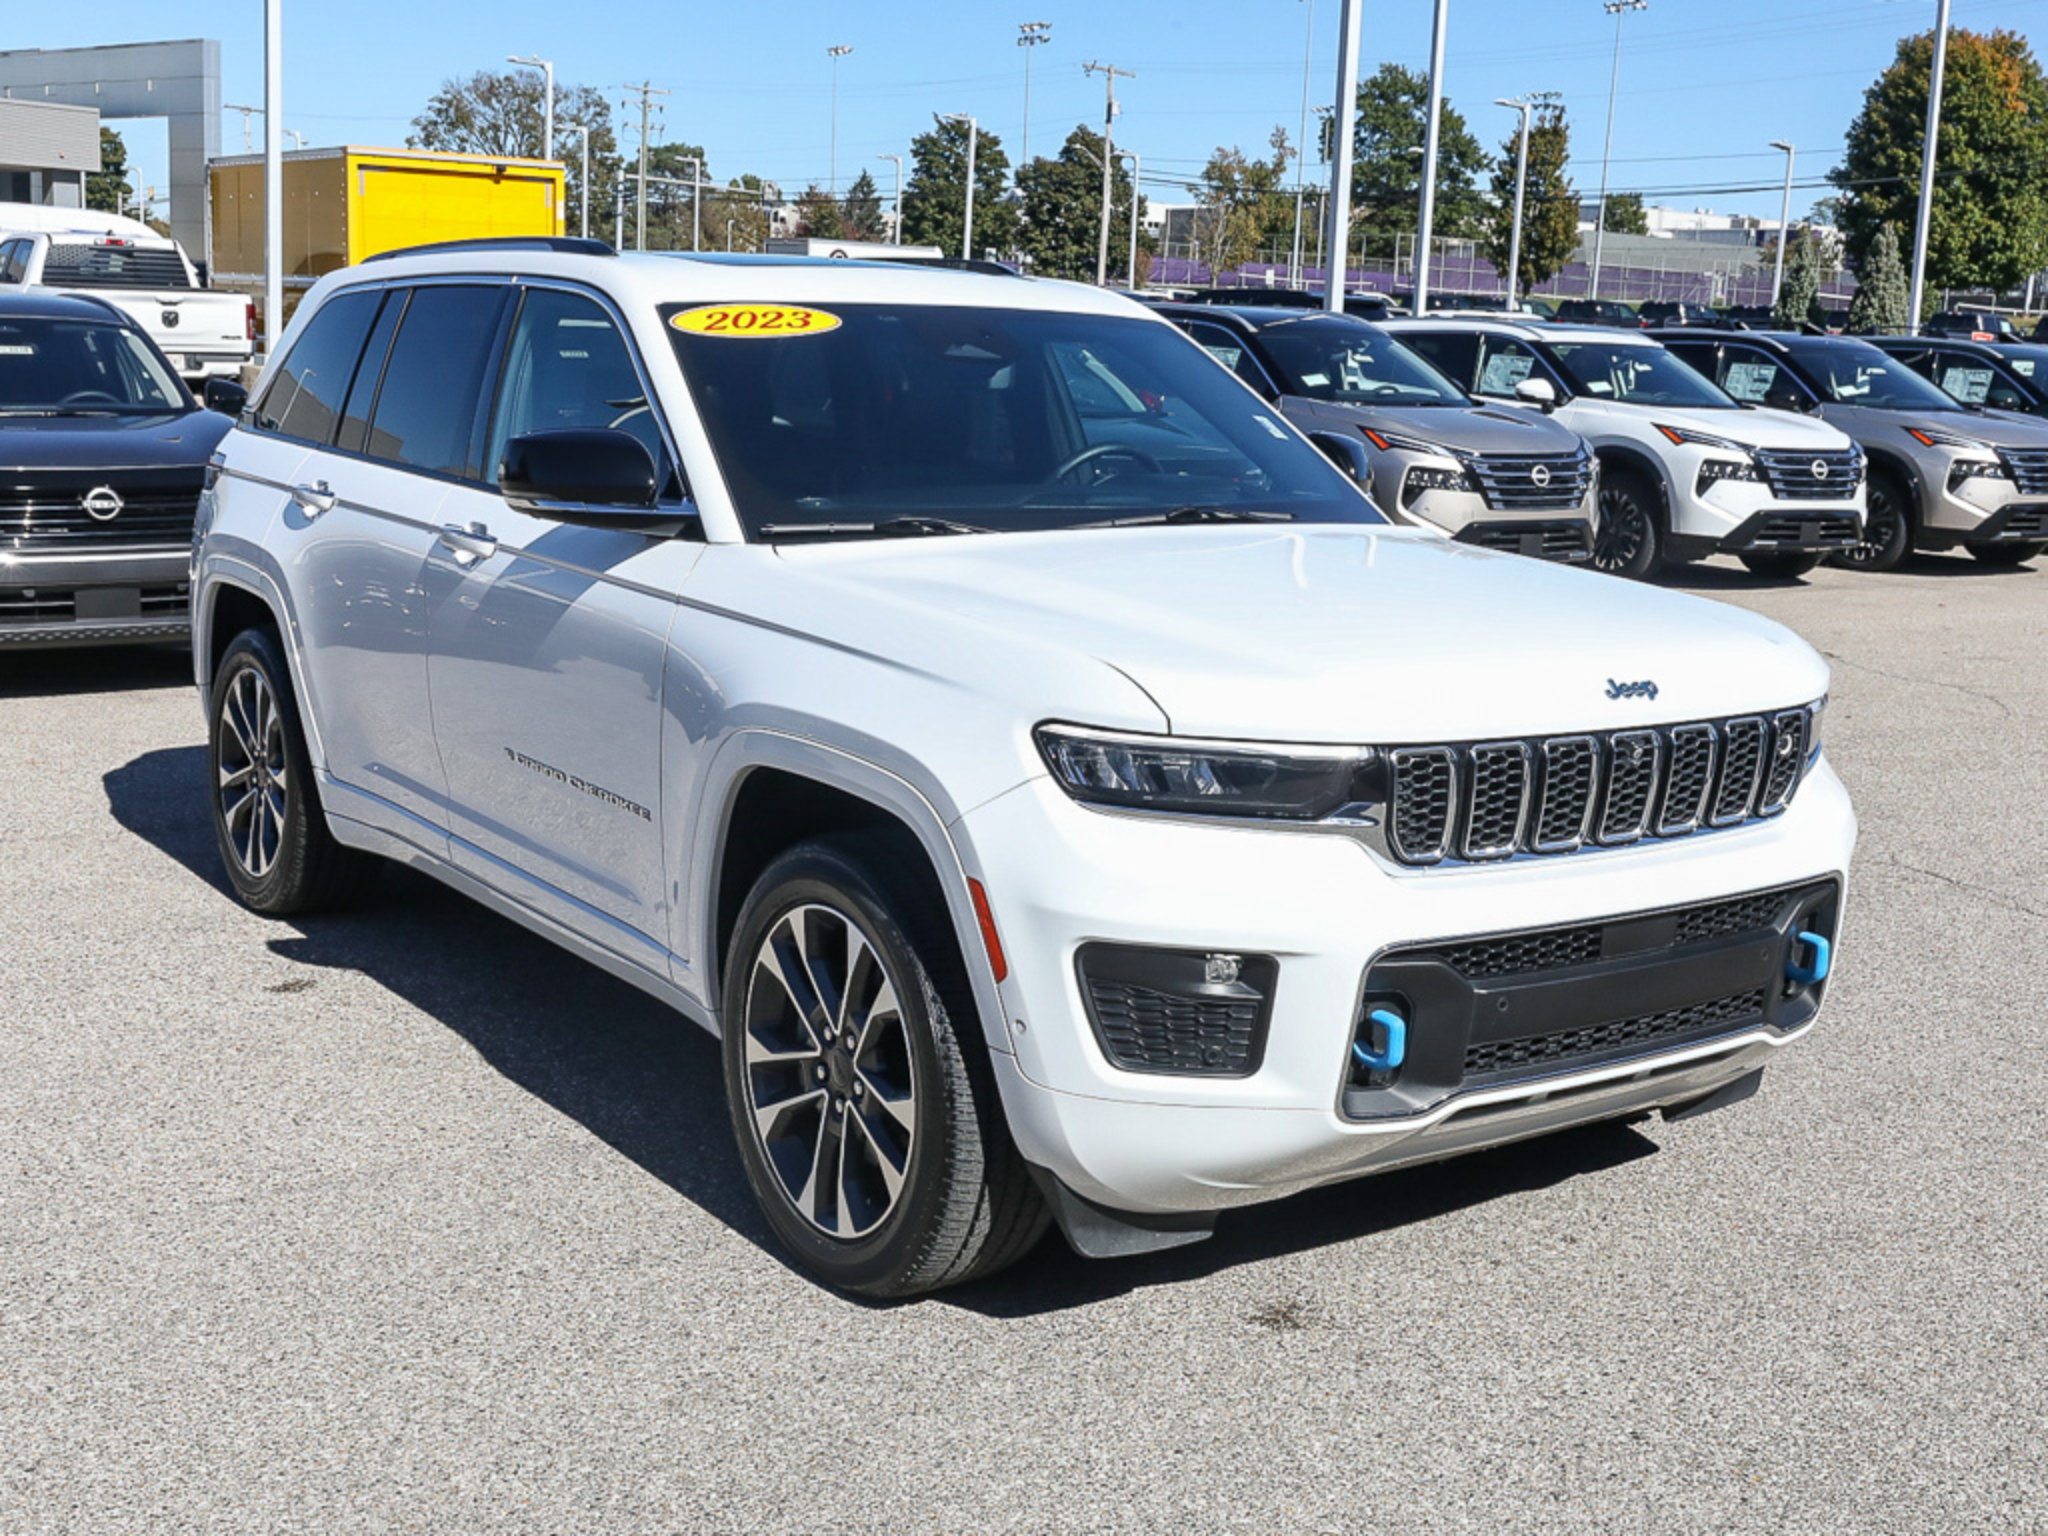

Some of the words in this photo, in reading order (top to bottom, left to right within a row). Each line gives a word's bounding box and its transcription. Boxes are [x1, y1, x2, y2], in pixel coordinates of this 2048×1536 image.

[704, 310, 812, 331] 2023
[1605, 678, 1659, 701] Jeep
[569, 775, 653, 823] CHEROKEE
